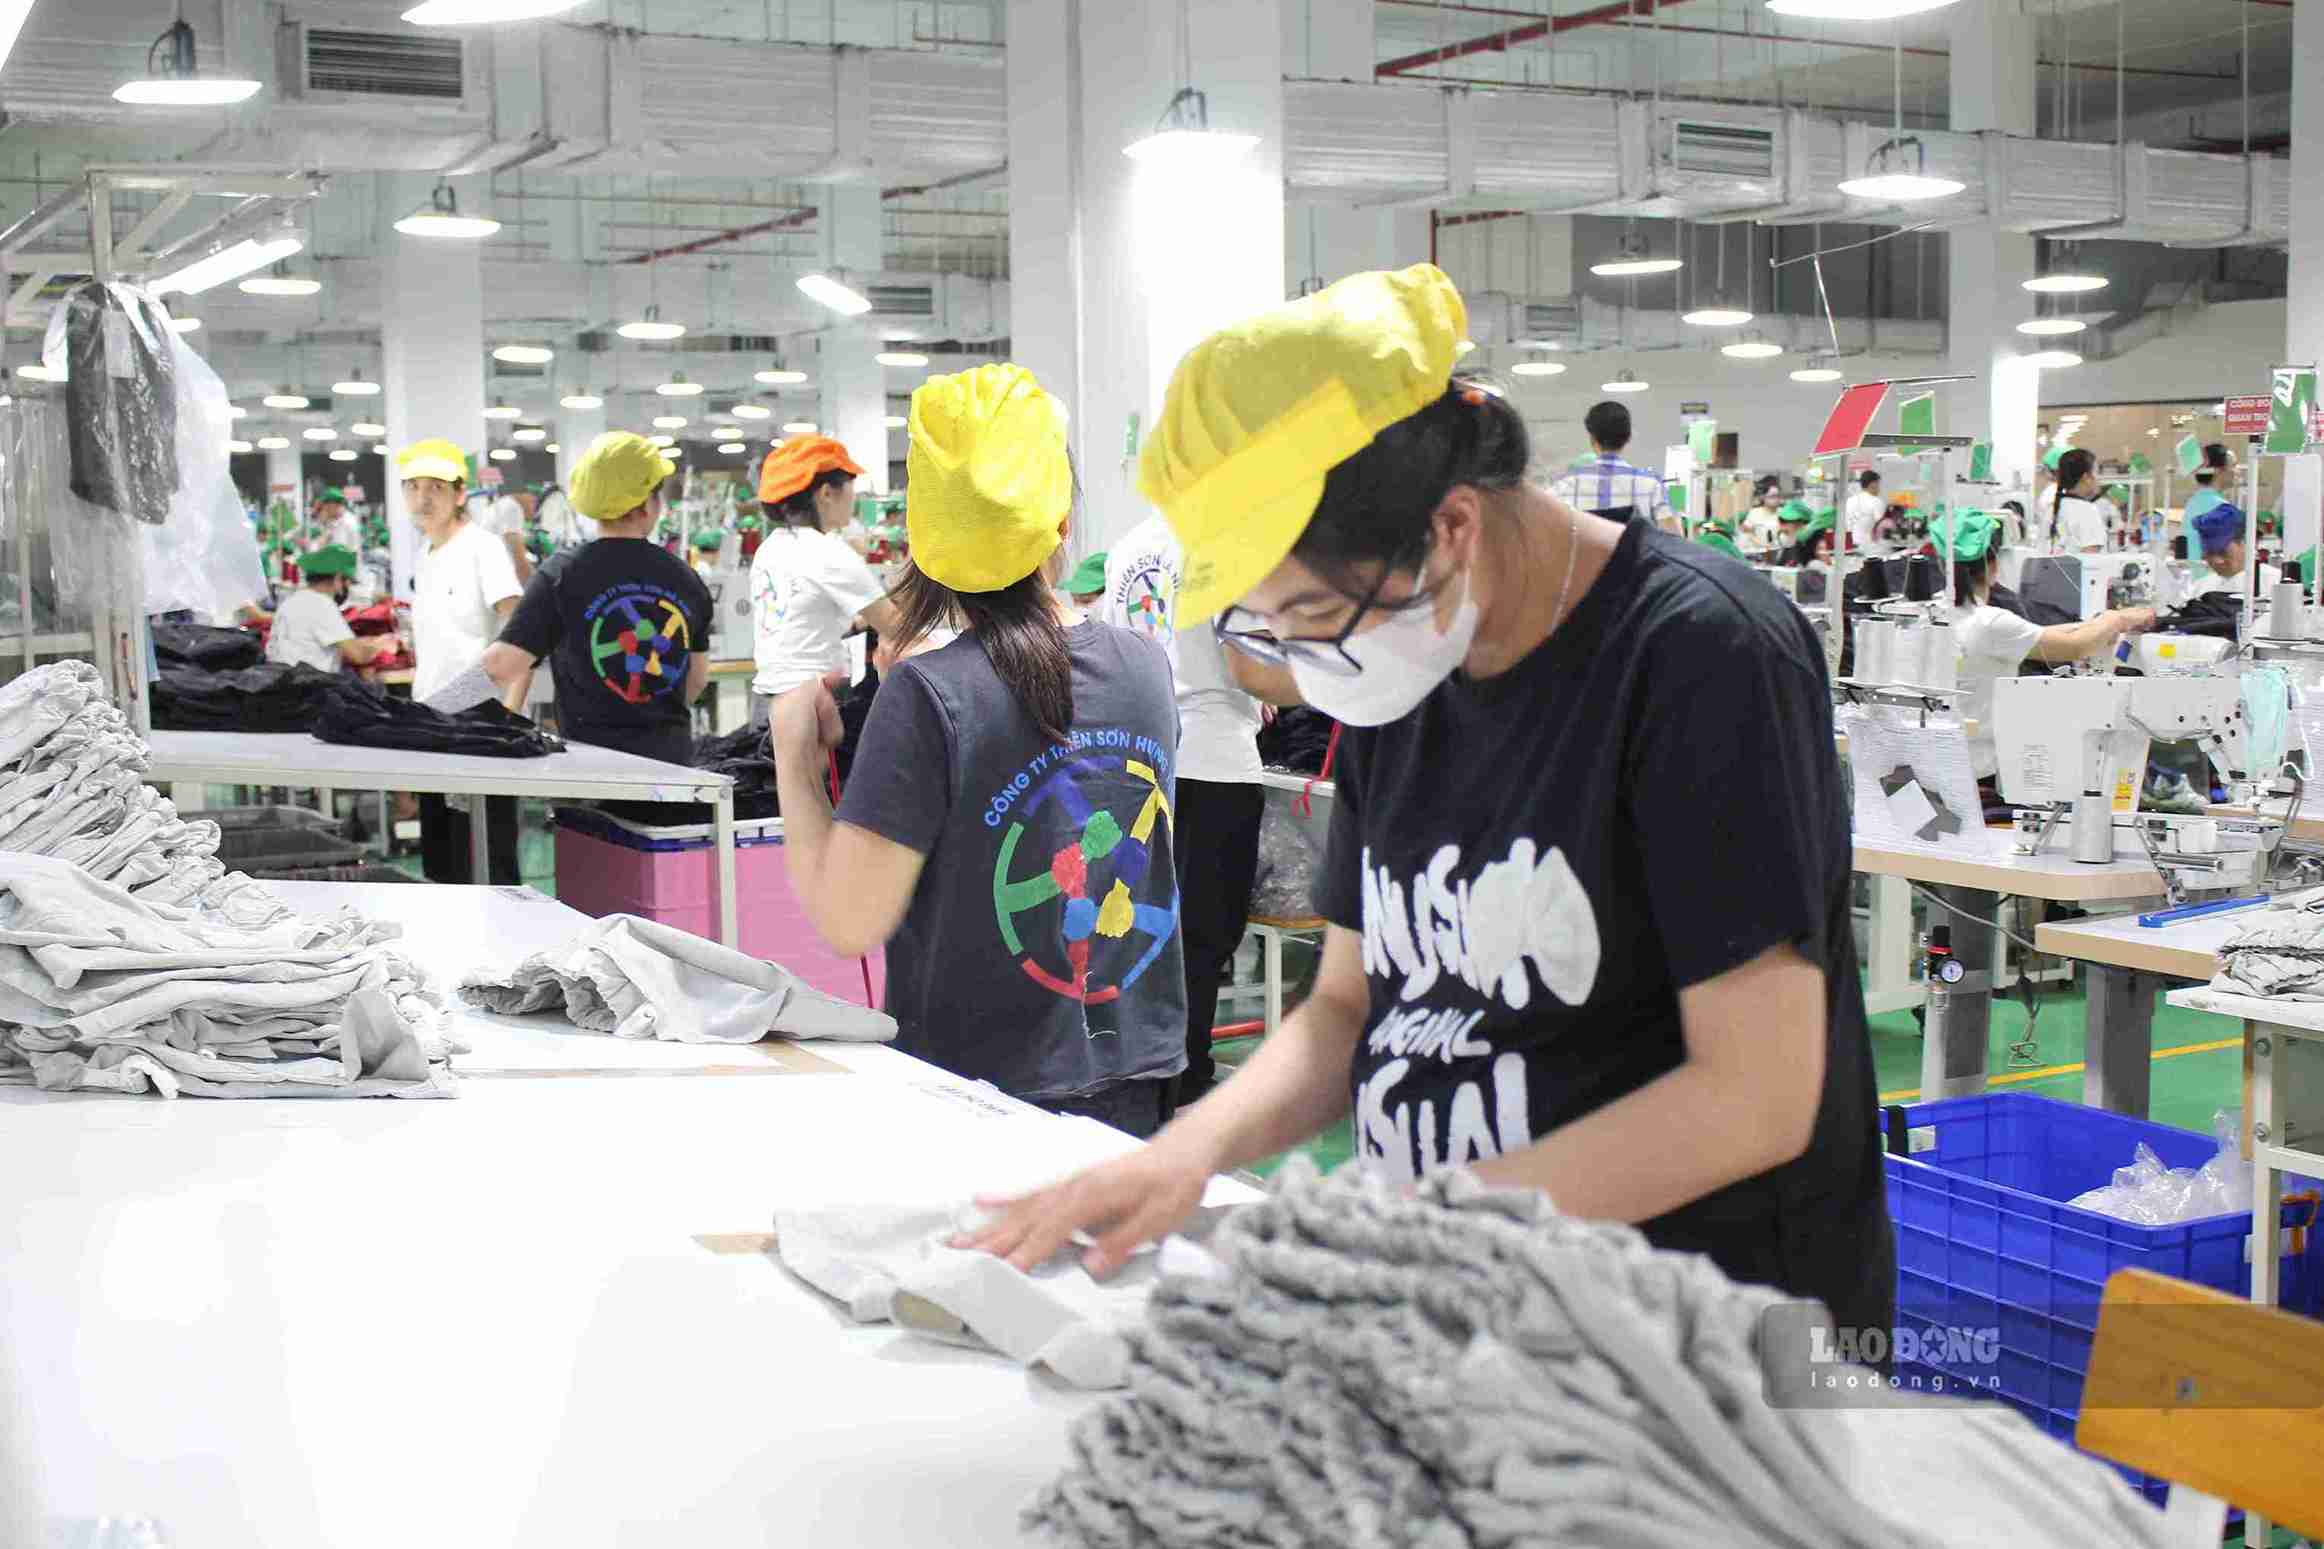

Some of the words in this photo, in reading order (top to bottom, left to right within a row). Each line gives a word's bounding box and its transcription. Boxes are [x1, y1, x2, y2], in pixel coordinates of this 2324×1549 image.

[983, 772, 1030, 827] CÔNG
[1029, 753, 1048, 775] TY
[1096, 727, 1131, 749] SƠN
